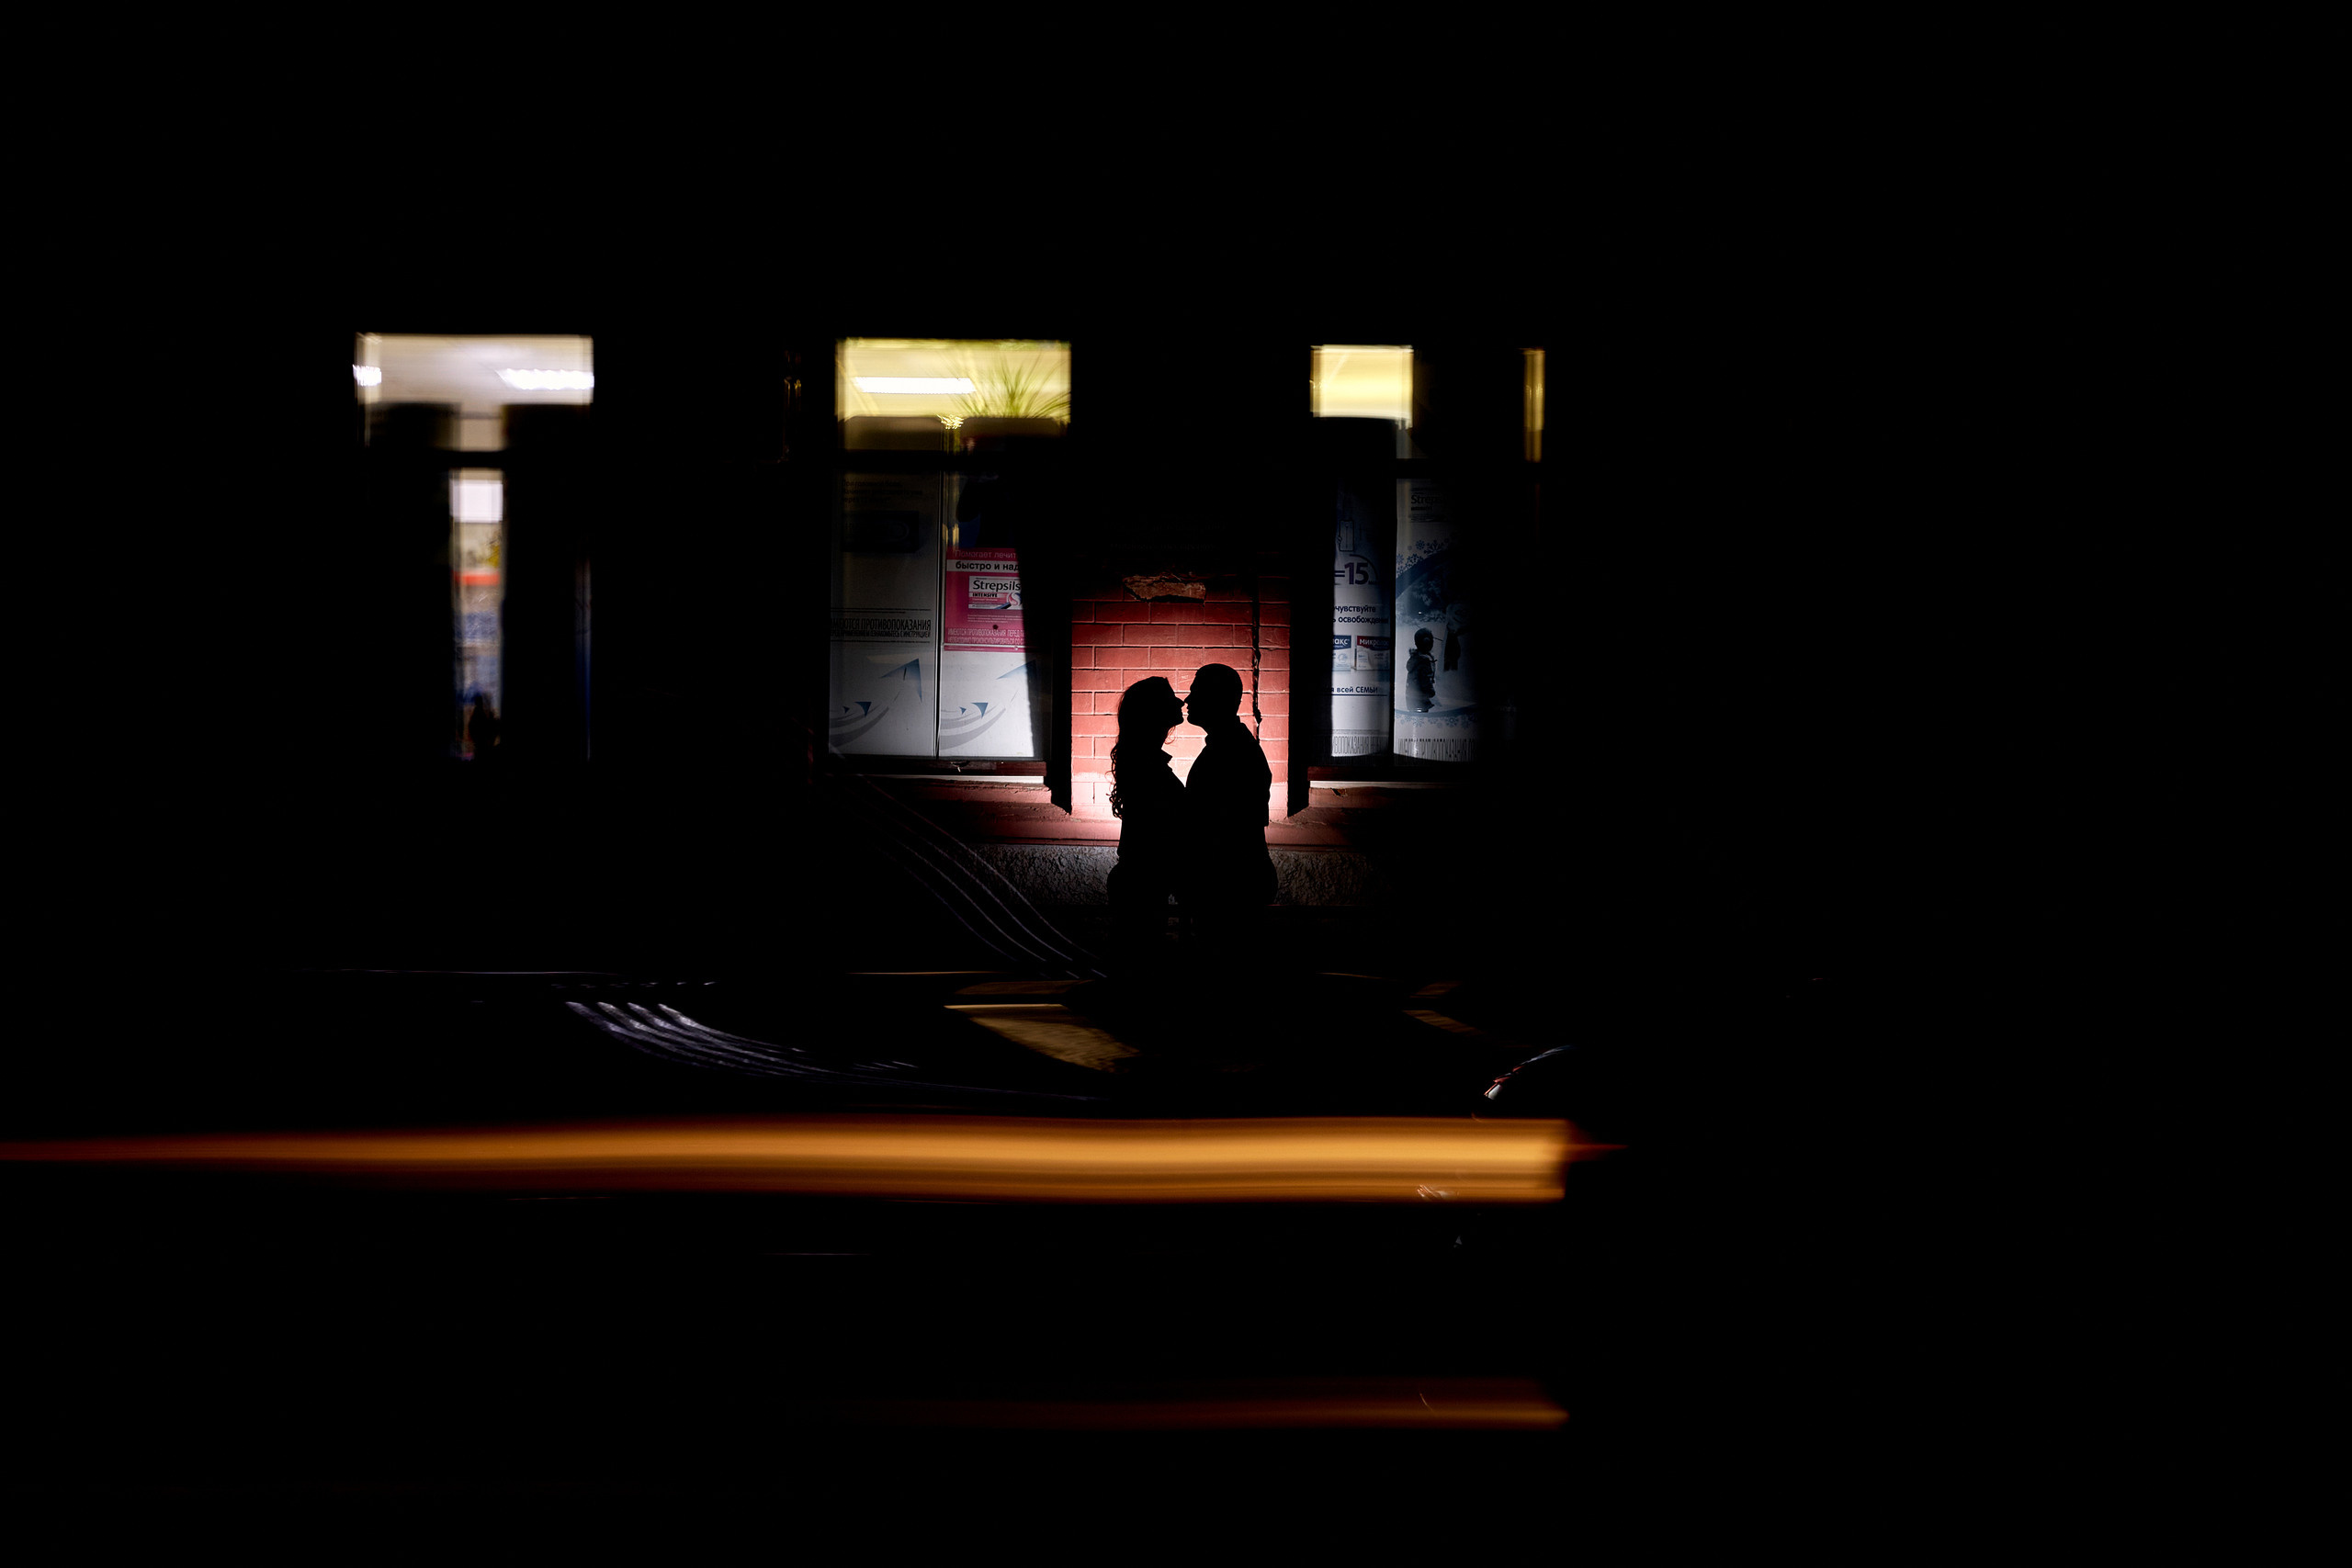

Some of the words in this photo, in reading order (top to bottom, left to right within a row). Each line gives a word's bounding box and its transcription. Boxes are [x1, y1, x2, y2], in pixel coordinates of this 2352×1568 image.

[955, 550, 991, 558] Помогает
[956, 561, 991, 571] быстро
[973, 580, 1021, 592] Strepsils
[861, 618, 932, 631] ПРОТИВОПОКАЗАНИЯ
